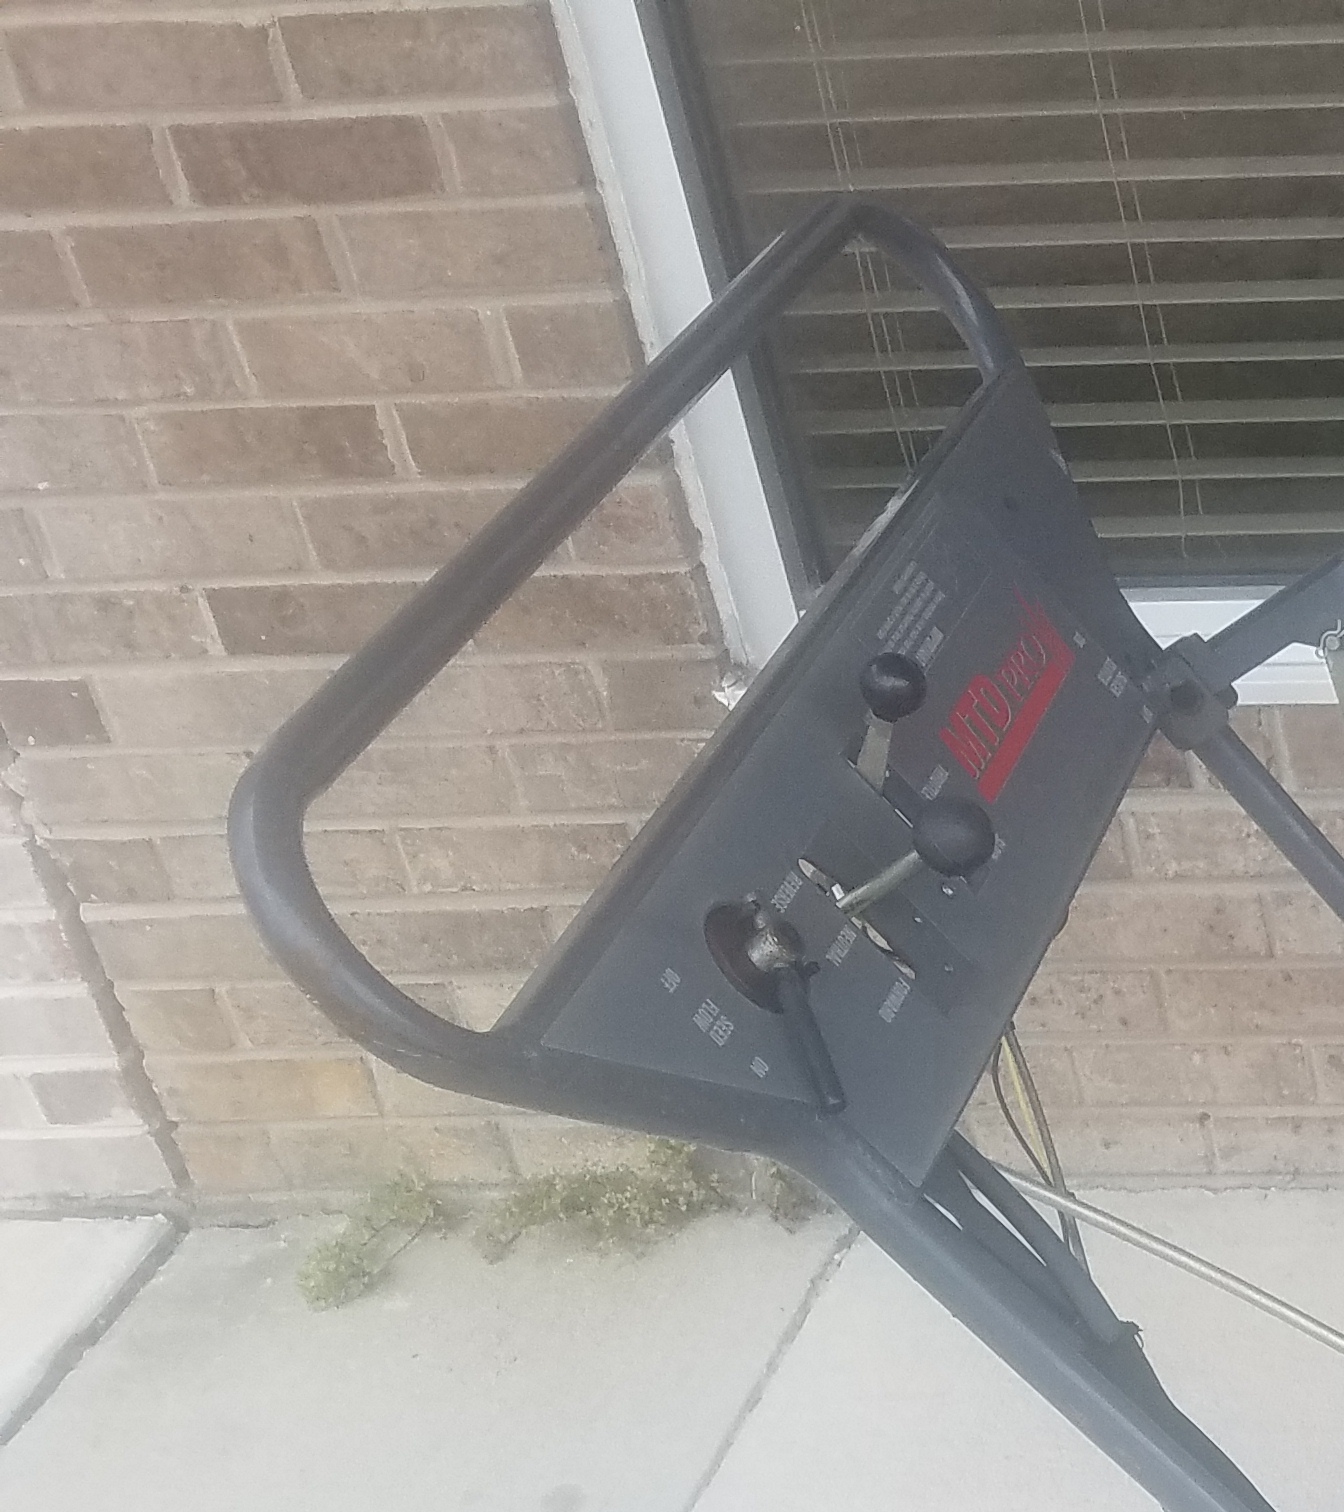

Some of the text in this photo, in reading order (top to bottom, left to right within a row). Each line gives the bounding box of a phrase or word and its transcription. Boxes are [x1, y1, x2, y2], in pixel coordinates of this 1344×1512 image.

[660, 967, 681, 993] OFF
[692, 998, 720, 1032] FLOW
[708, 1015, 734, 1047] SEED
[750, 1056, 769, 1078] ON
